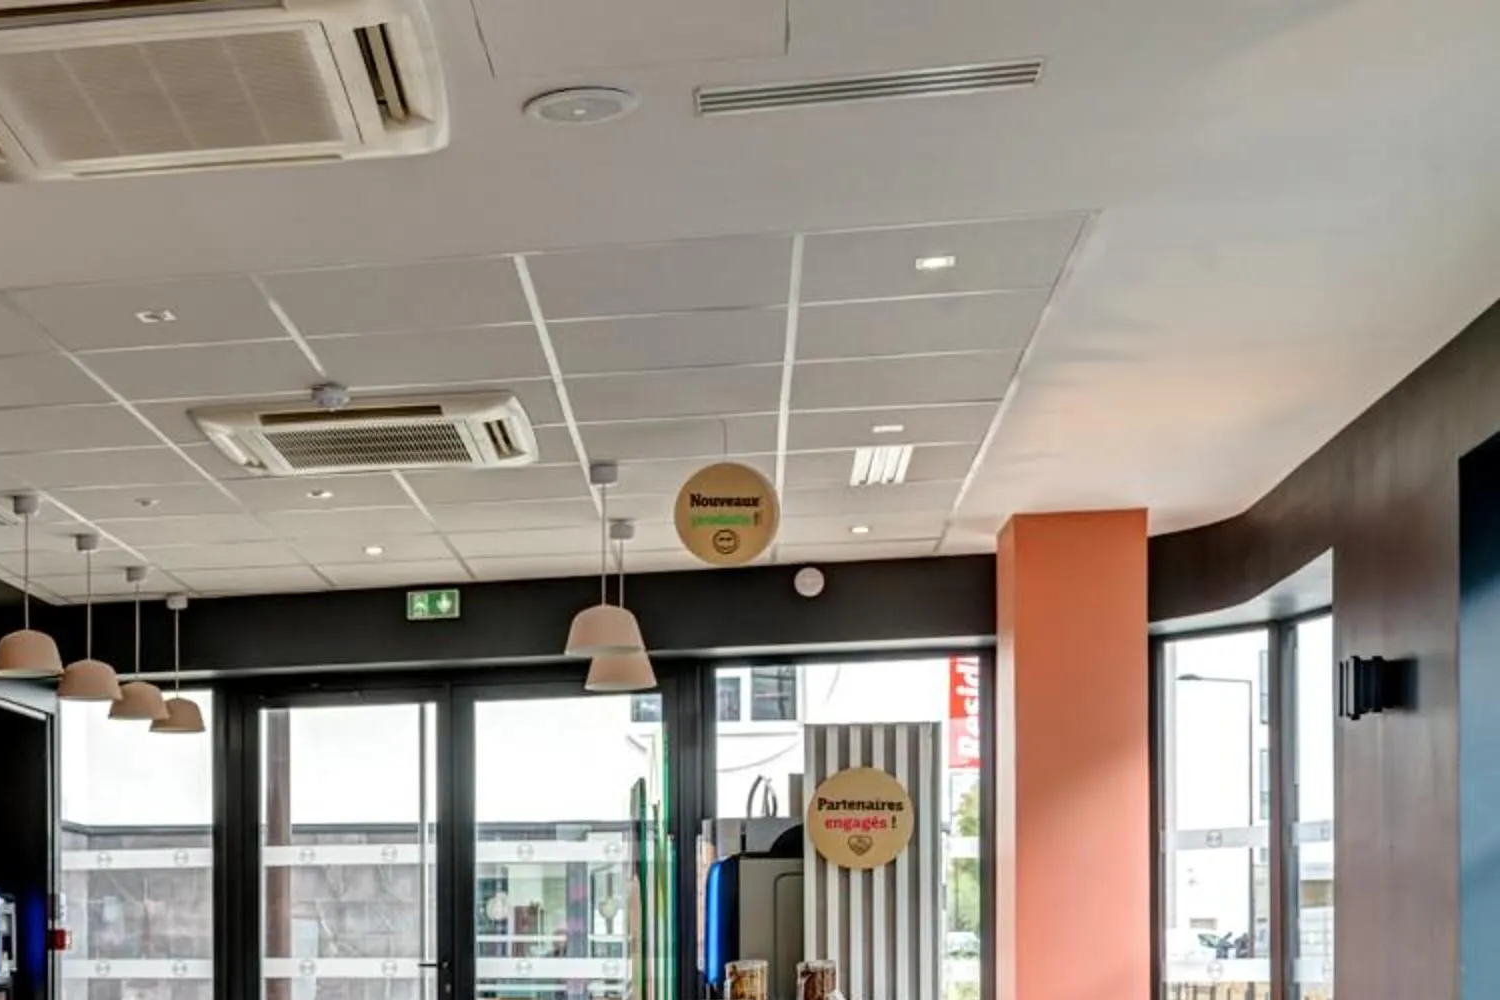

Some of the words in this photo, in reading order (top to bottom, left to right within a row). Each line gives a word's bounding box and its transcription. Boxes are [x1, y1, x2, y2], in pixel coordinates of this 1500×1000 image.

[818, 797, 903, 811] Partenaires
[824, 815, 887, 831] engagés
[891, 815, 897, 829] !
